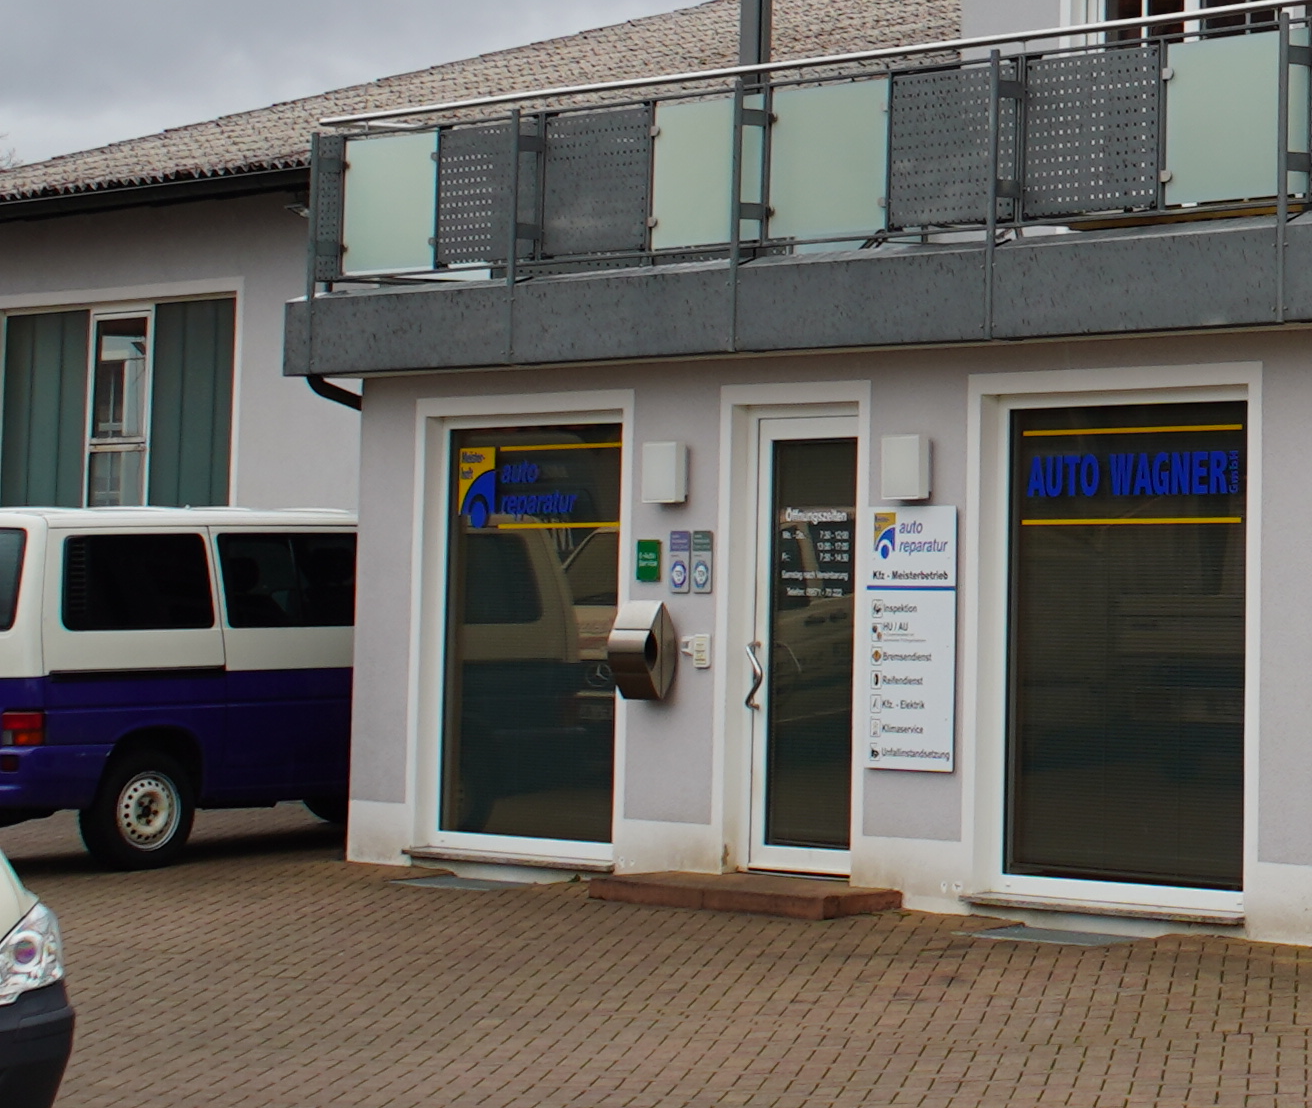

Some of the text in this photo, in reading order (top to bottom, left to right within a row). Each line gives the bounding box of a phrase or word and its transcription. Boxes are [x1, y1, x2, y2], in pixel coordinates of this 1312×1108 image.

[501, 460, 540, 483] auto
[1027, 450, 1239, 497] AUTO WAGNER GmbH
[501, 490, 578, 520] reparatur
[785, 507, 848, 524] Öffnungszeiten
[899, 520, 923, 534] auto
[899, 538, 948, 556] reparatur
[873, 570, 885, 580] Kfz
[891, 570, 948, 580] Meisterbetrieb
[883, 603, 917, 615] Inspektion
[883, 651, 932, 662] Bremsendienst
[882, 675, 923, 685] Reifendienst
[900, 699, 925, 709] Elektrik
[882, 724, 923, 734] Klimaservice
[881, 748, 950, 761] Unfallinstandsetzung
